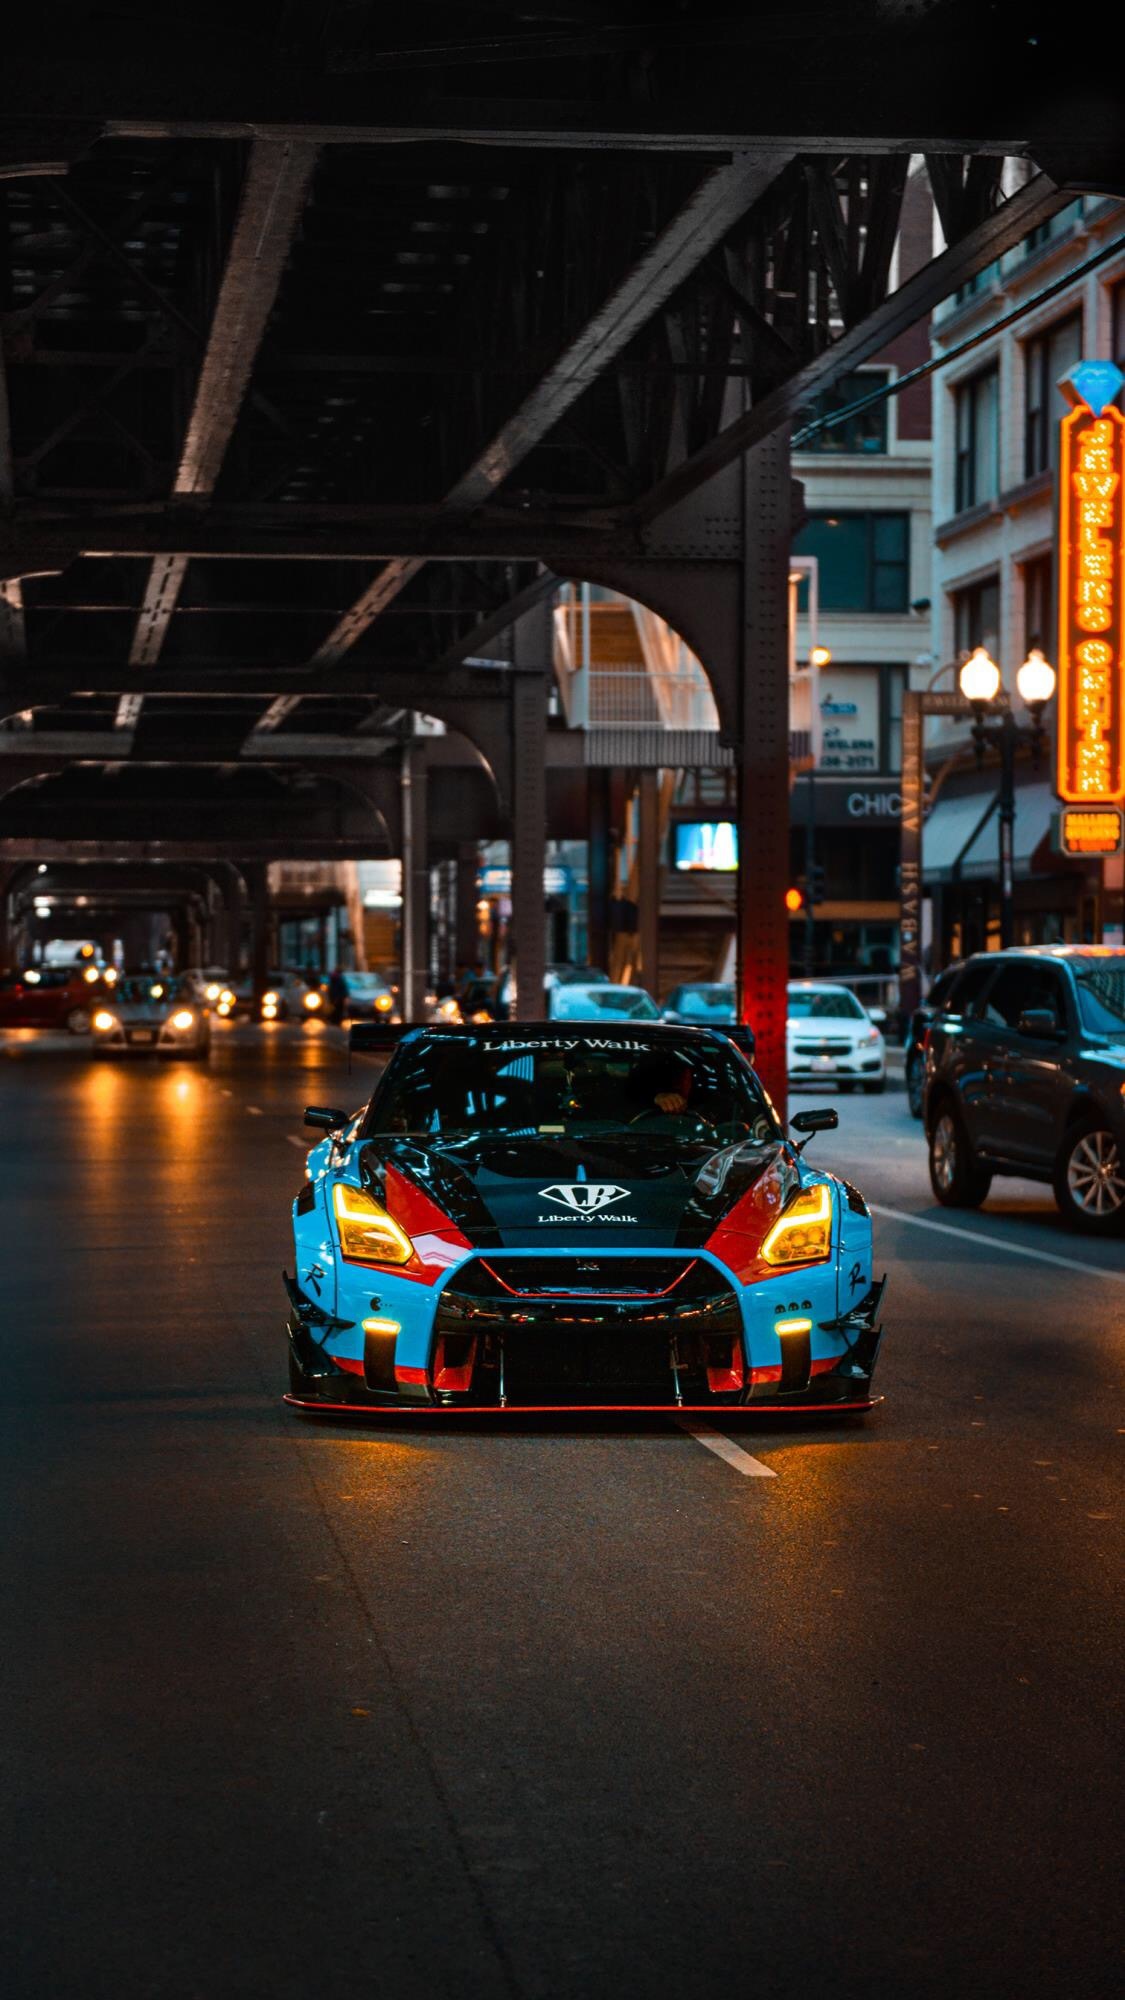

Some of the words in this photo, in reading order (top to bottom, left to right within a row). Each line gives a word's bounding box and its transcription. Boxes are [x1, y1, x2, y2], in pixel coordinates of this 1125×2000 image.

[483, 1038, 580, 1051] Liberty
[583, 1038, 650, 1051] Walk
[537, 1214, 597, 1223] Liberty
[597, 1214, 638, 1223] Walk
